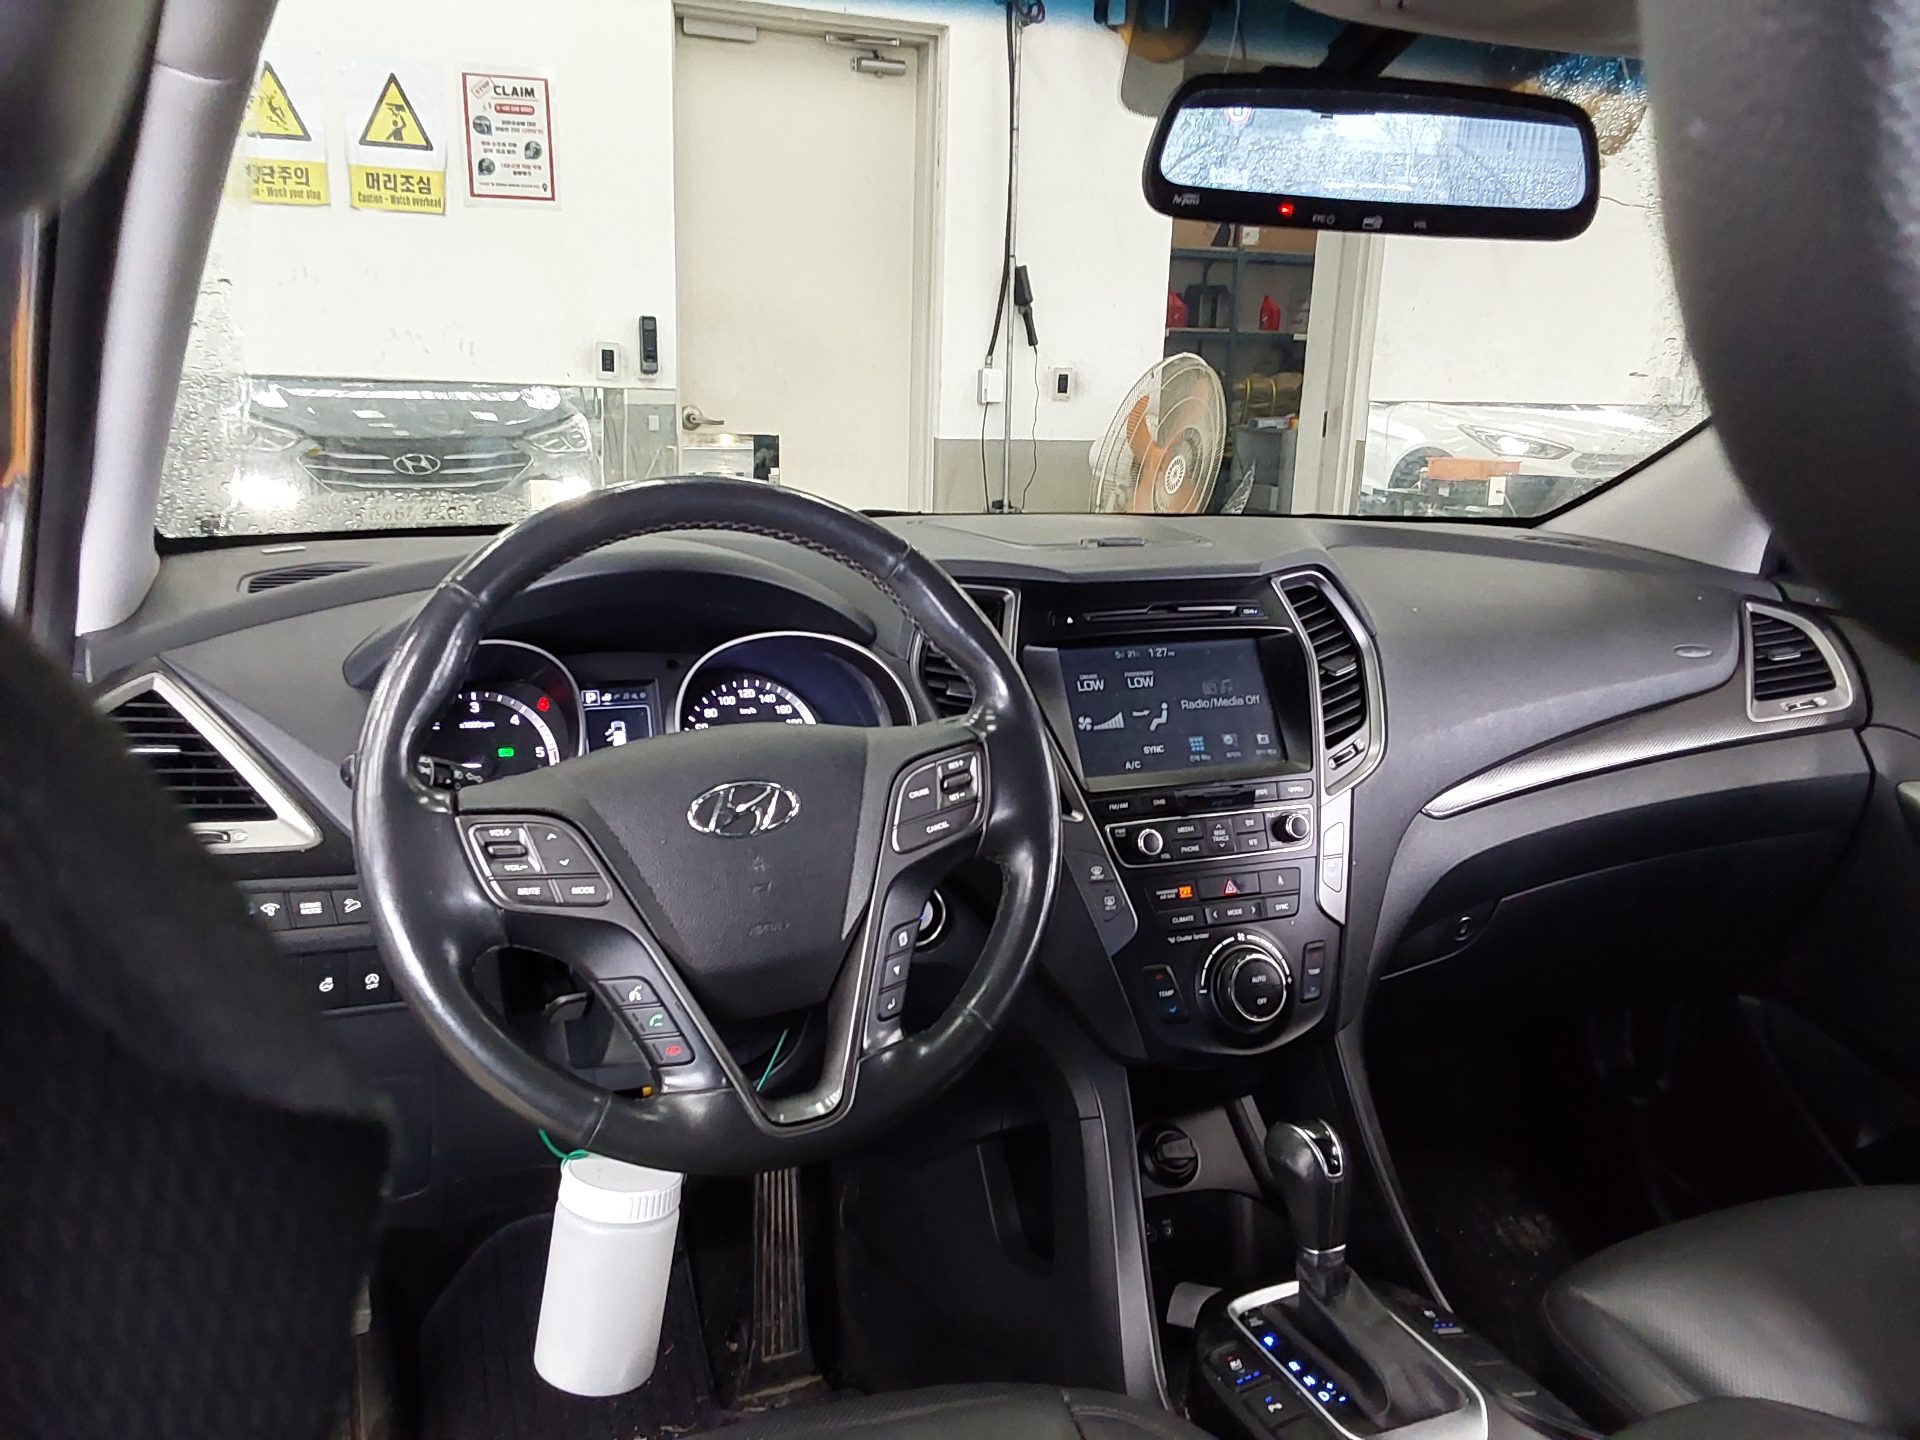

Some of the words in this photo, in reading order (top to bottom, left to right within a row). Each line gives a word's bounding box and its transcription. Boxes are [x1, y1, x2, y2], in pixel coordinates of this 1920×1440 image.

[493, 85, 536, 98] CLAIM
[366, 172, 431, 194] 머리조심
[290, 189, 303, 199] your
[358, 192, 383, 204] Caution
[390, 194, 410, 205] Watch
[412, 195, 442, 208] overhead
[1077, 679, 1104, 692] LOW
[1127, 676, 1154, 689] LOW
[737, 688, 756, 699] 120
[718, 696, 736, 706] 100
[758, 694, 776, 704] 140
[1181, 695, 1244, 710] Radio/Media
[1245, 694, 1261, 705] Off
[469, 702, 480, 714] 3
[703, 708, 718, 718] 80
[774, 704, 792, 715] 160
[509, 714, 520, 726] 4
[535, 746, 545, 758] 5
[1143, 745, 1165, 755] SYNC
[1125, 761, 1142, 770] A/C
[1109, 801, 1129, 811] FM/AM
[926, 821, 950, 834] CANCEL
[1181, 845, 1200, 853] PHONE
[517, 887, 541, 895] MUTE
[571, 886, 595, 895] MODE
[1227, 908, 1243, 916] MODE
[1275, 903, 1289, 911] SYNC
[1172, 915, 1194, 924] CLIMATE
[1307, 968, 1321, 976] TEMP
[1251, 975, 1267, 984] AUTO
[1159, 989, 1174, 998] TEMP
[1257, 997, 1267, 1005] OFF
[1288, 1361, 1301, 1372] R
[1303, 1375, 1316, 1387] N
[1318, 1391, 1330, 1402] D
